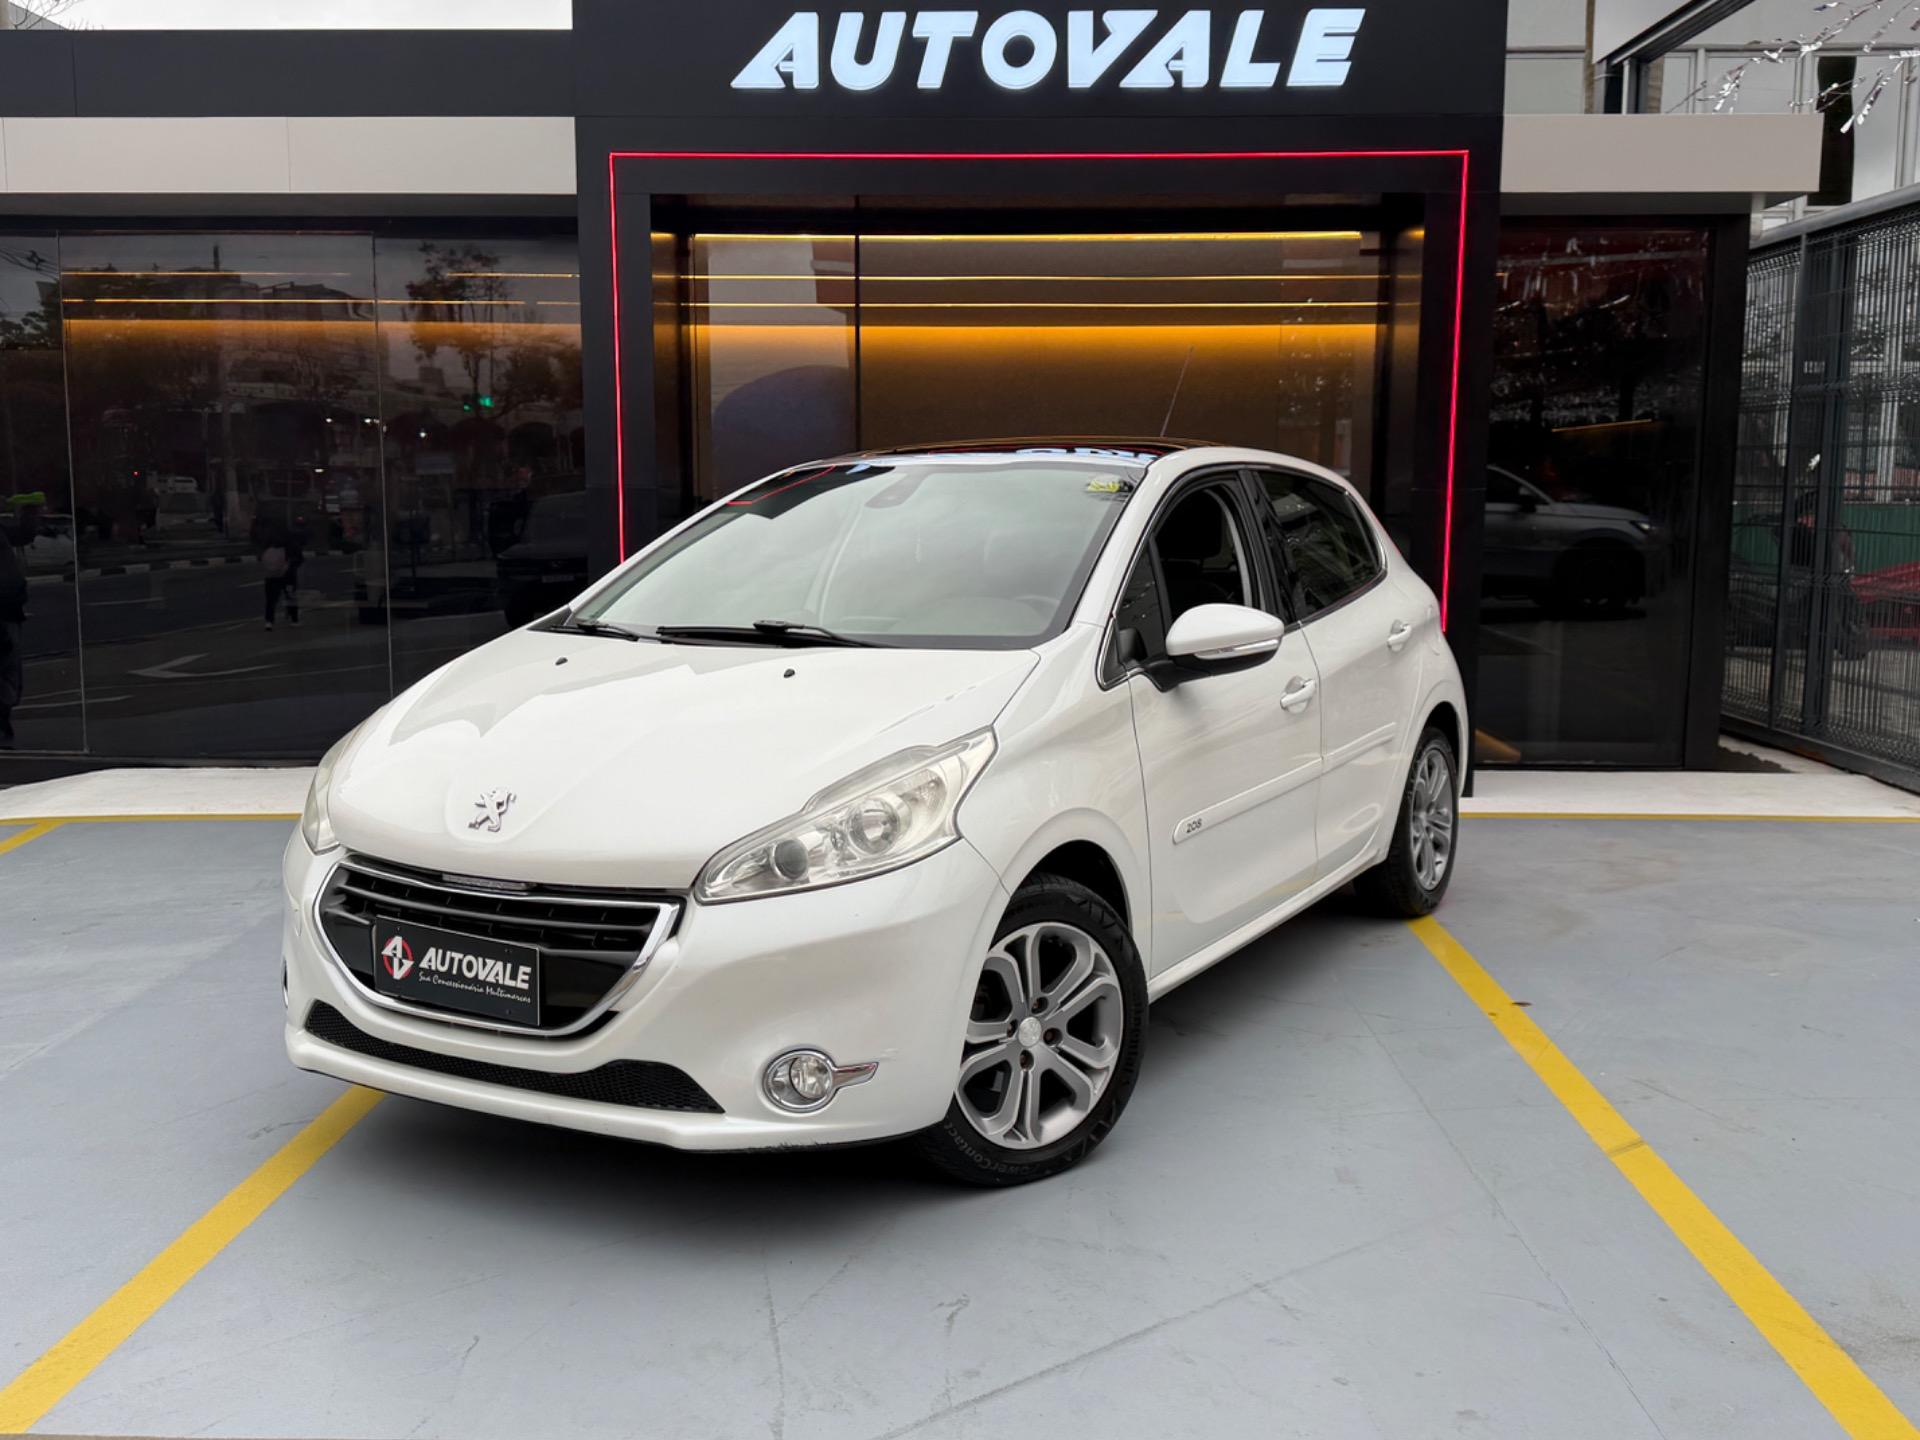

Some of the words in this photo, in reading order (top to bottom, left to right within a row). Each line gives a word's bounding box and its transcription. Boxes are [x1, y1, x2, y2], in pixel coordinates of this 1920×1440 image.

[730, 8, 1366, 90] AUTOVALE
[1186, 817, 1202, 834] 208
[419, 947, 531, 989] AUTOVALE
[418, 971, 431, 982] Sua
[486, 986, 531, 1003] Multimarcas
